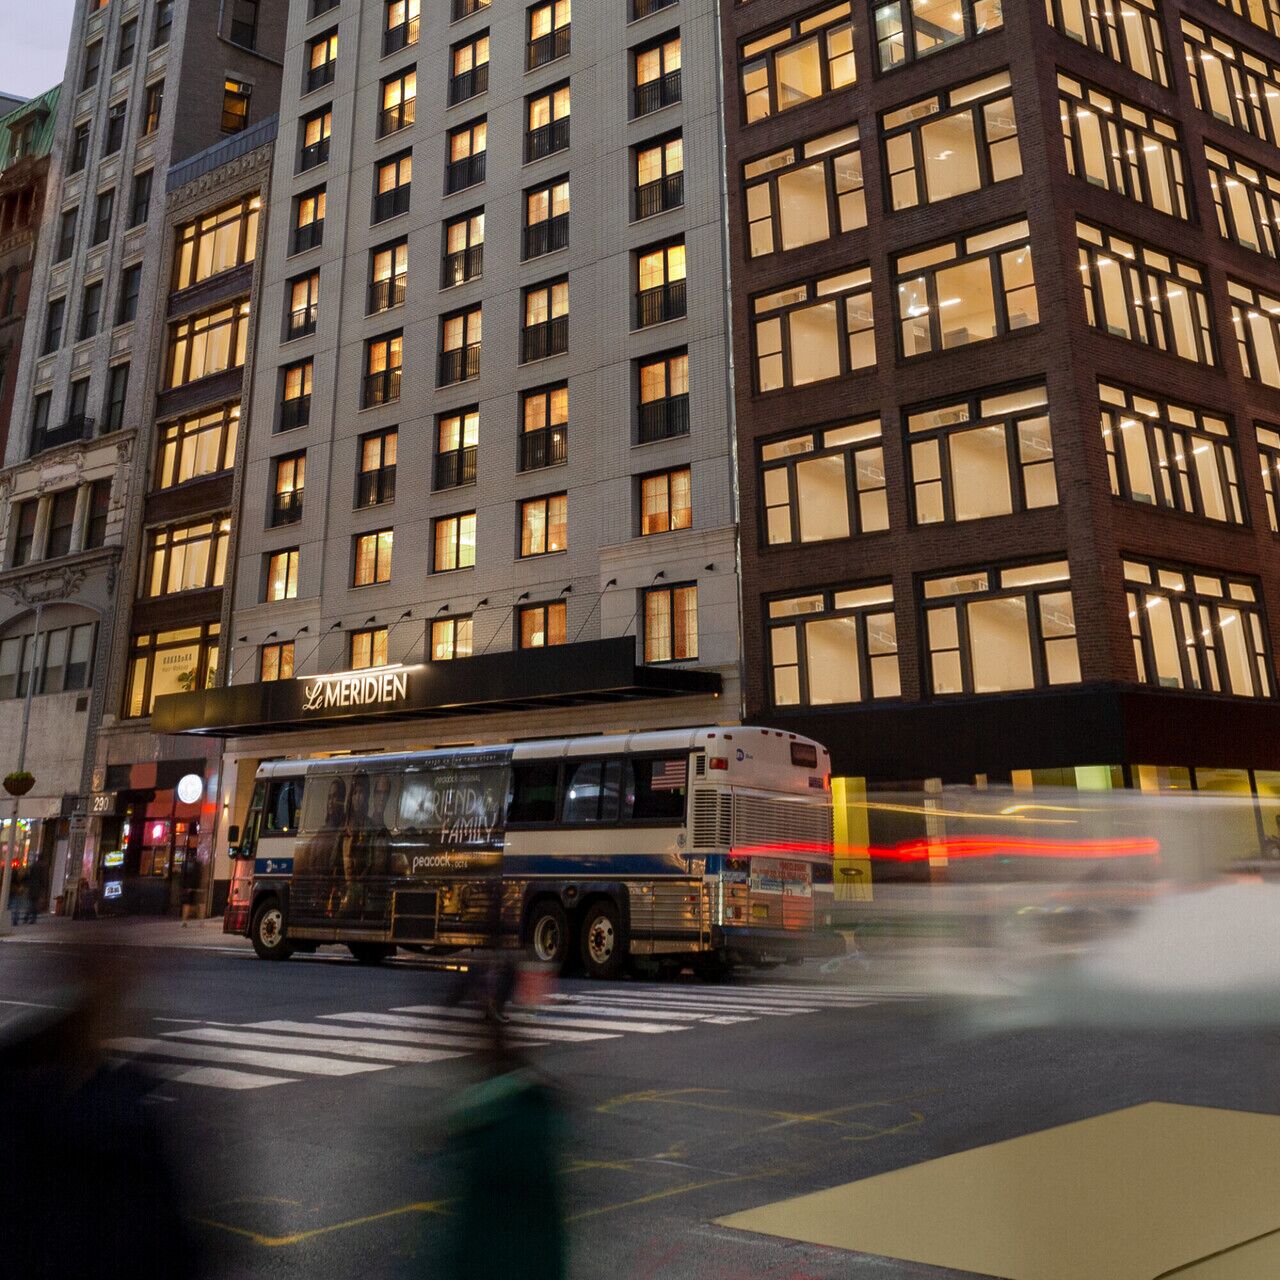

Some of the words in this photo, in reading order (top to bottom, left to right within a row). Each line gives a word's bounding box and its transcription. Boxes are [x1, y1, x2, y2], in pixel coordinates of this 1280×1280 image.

[302, 680, 323, 710] Le
[324, 673, 408, 708] MERIDIEN
[93, 796, 110, 812] 290
[440, 813, 498, 845] FAMILY
[412, 851, 451, 874] peacock
